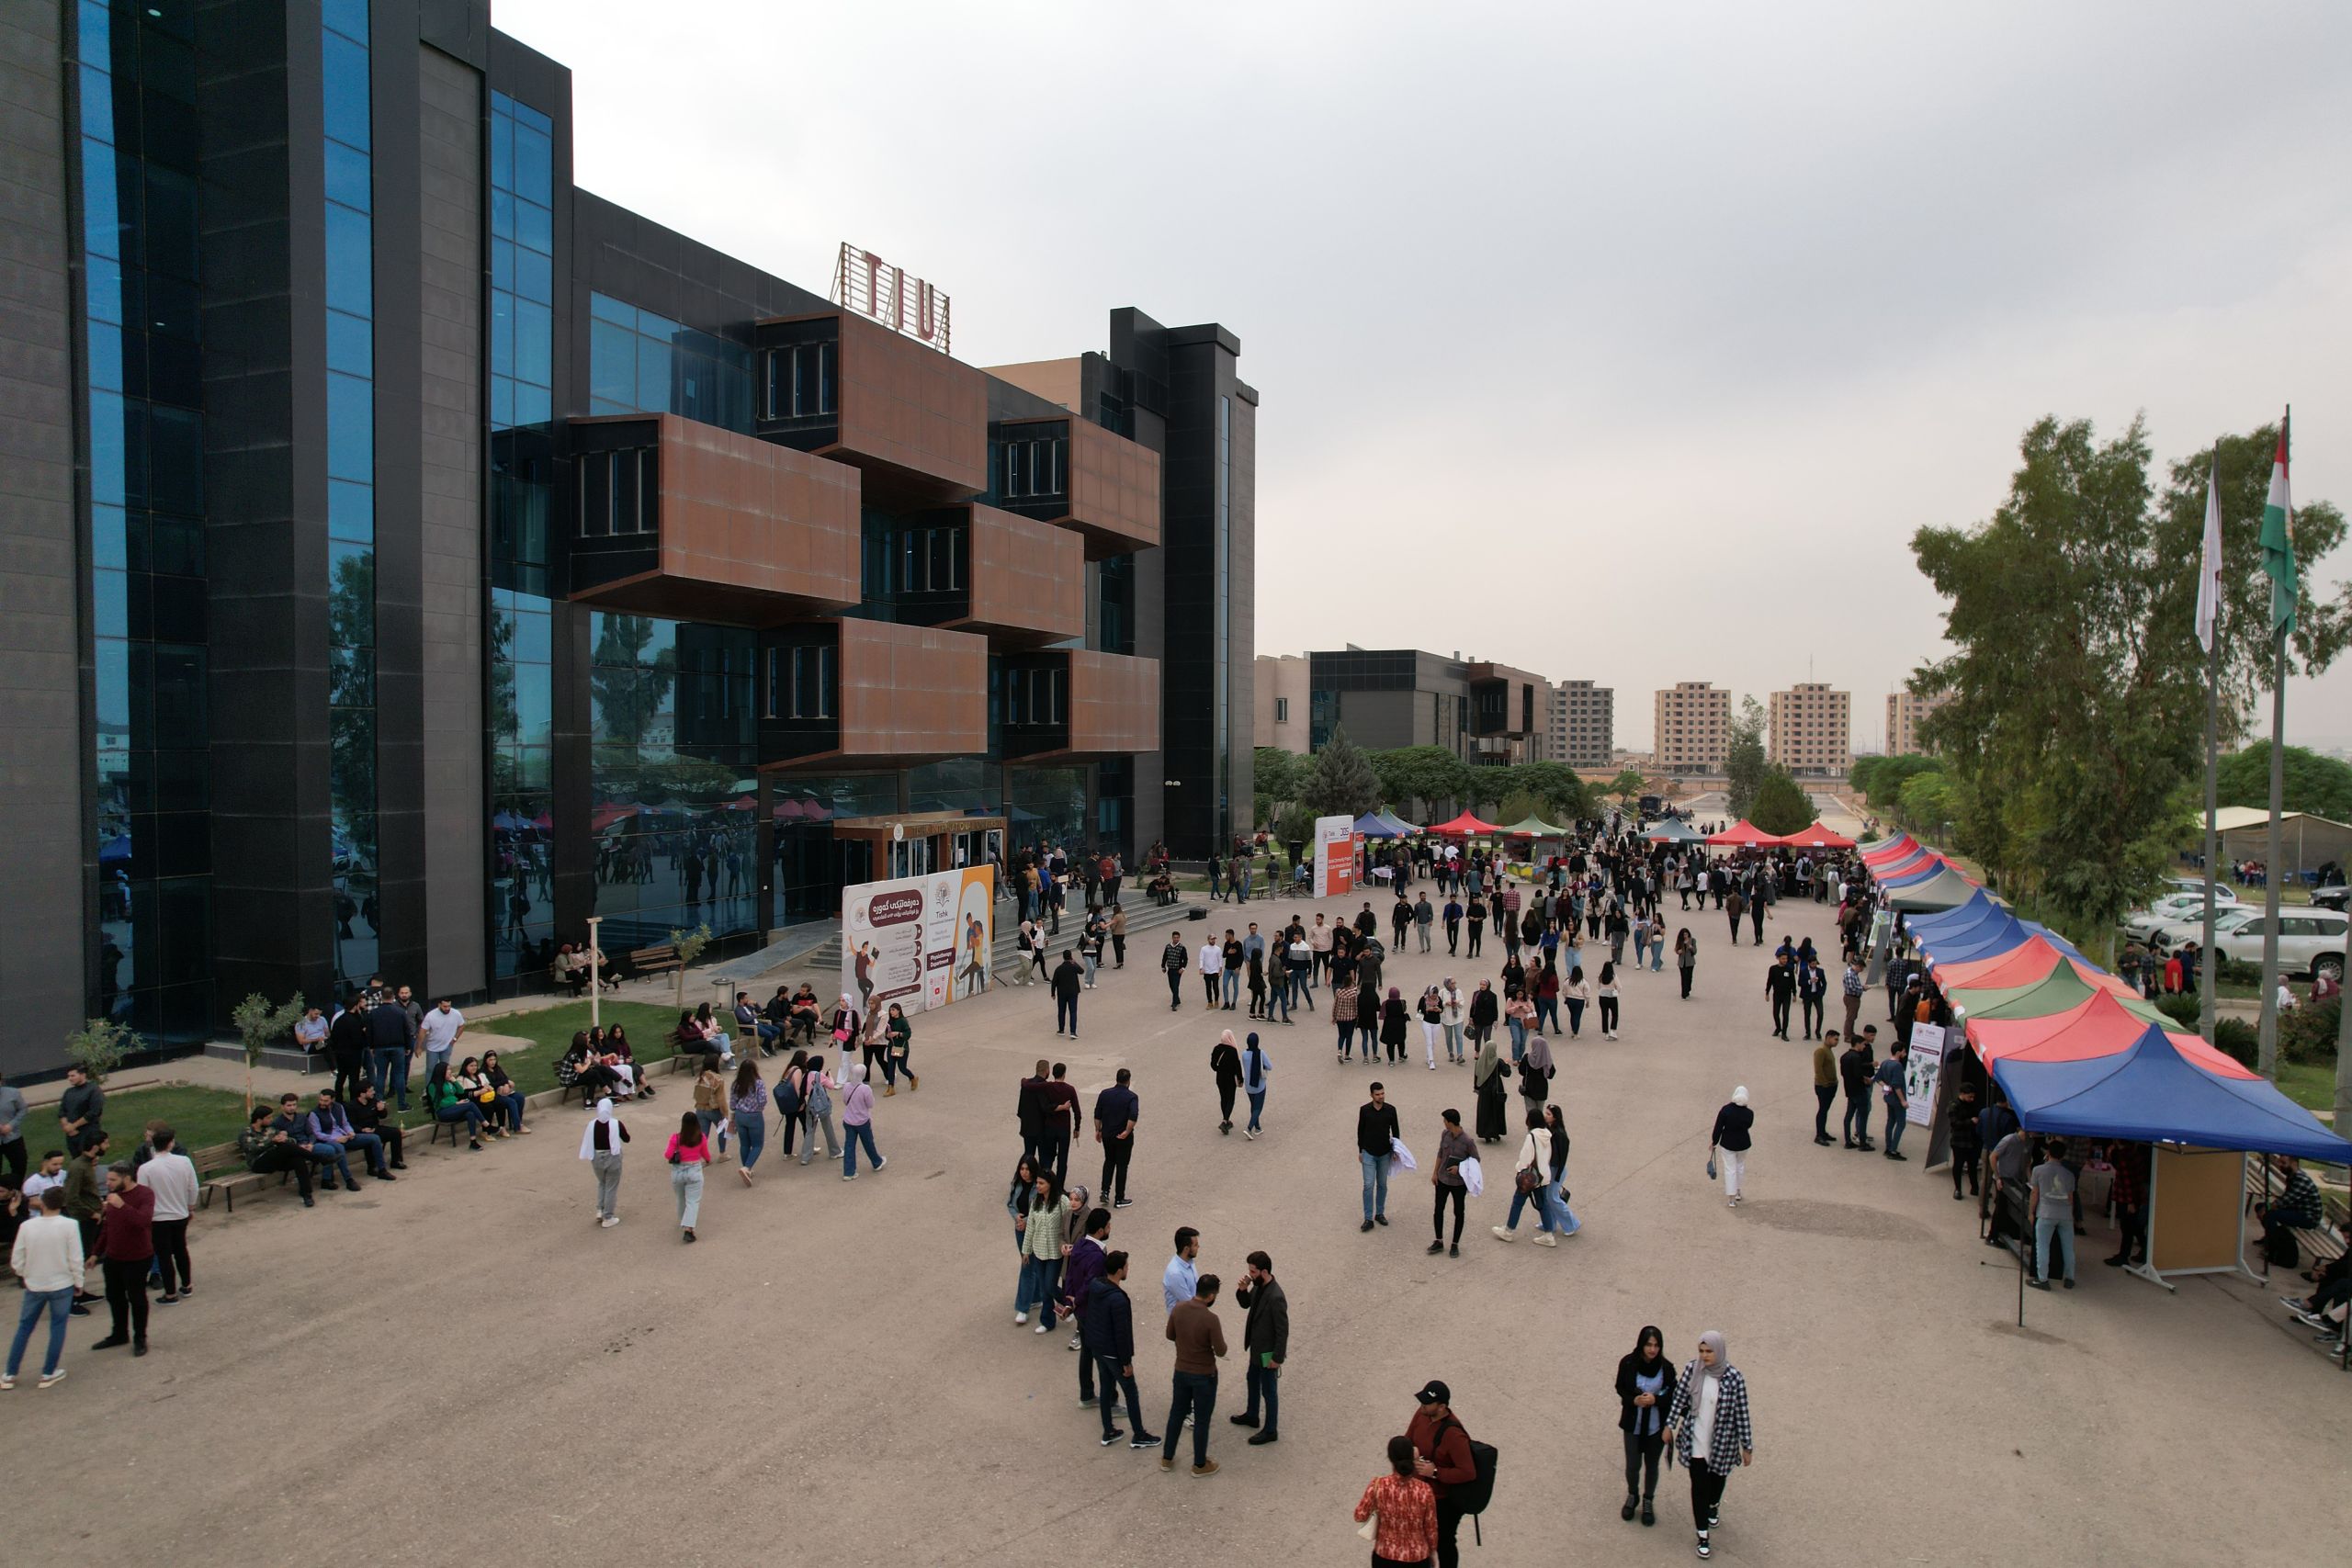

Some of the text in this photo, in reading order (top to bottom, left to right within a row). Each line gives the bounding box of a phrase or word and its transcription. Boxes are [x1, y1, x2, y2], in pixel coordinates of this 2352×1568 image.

[861, 250, 934, 341] TIU
[932, 822, 974, 834] INTERNATIONA
[873, 899, 889, 915] گەورە
[935, 910, 949, 919] Tishk
[930, 951, 953, 961] Physiotherapy
[930, 958, 949, 967] Department
